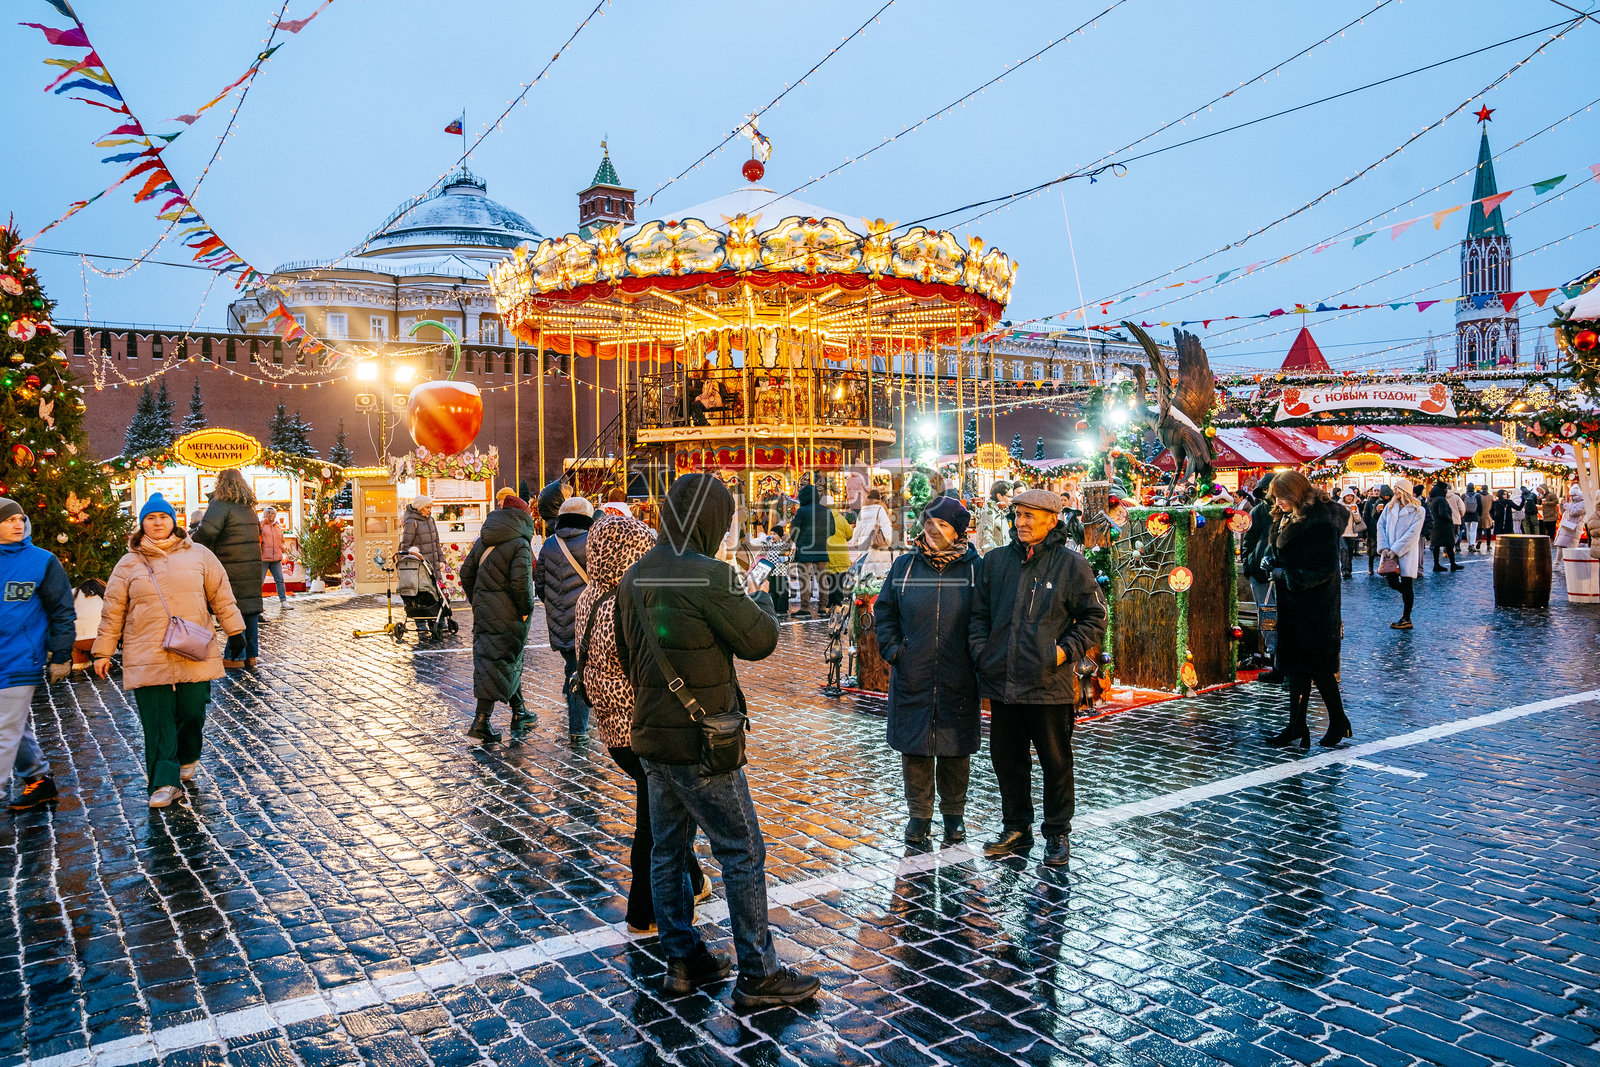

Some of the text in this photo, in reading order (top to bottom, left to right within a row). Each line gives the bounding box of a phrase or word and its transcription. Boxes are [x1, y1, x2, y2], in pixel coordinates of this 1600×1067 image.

[1313, 391, 1417, 404] С НОВЫМ ГОДОМ!
[187, 443, 249, 451] МЕГРЕЛЬСКИЙ
